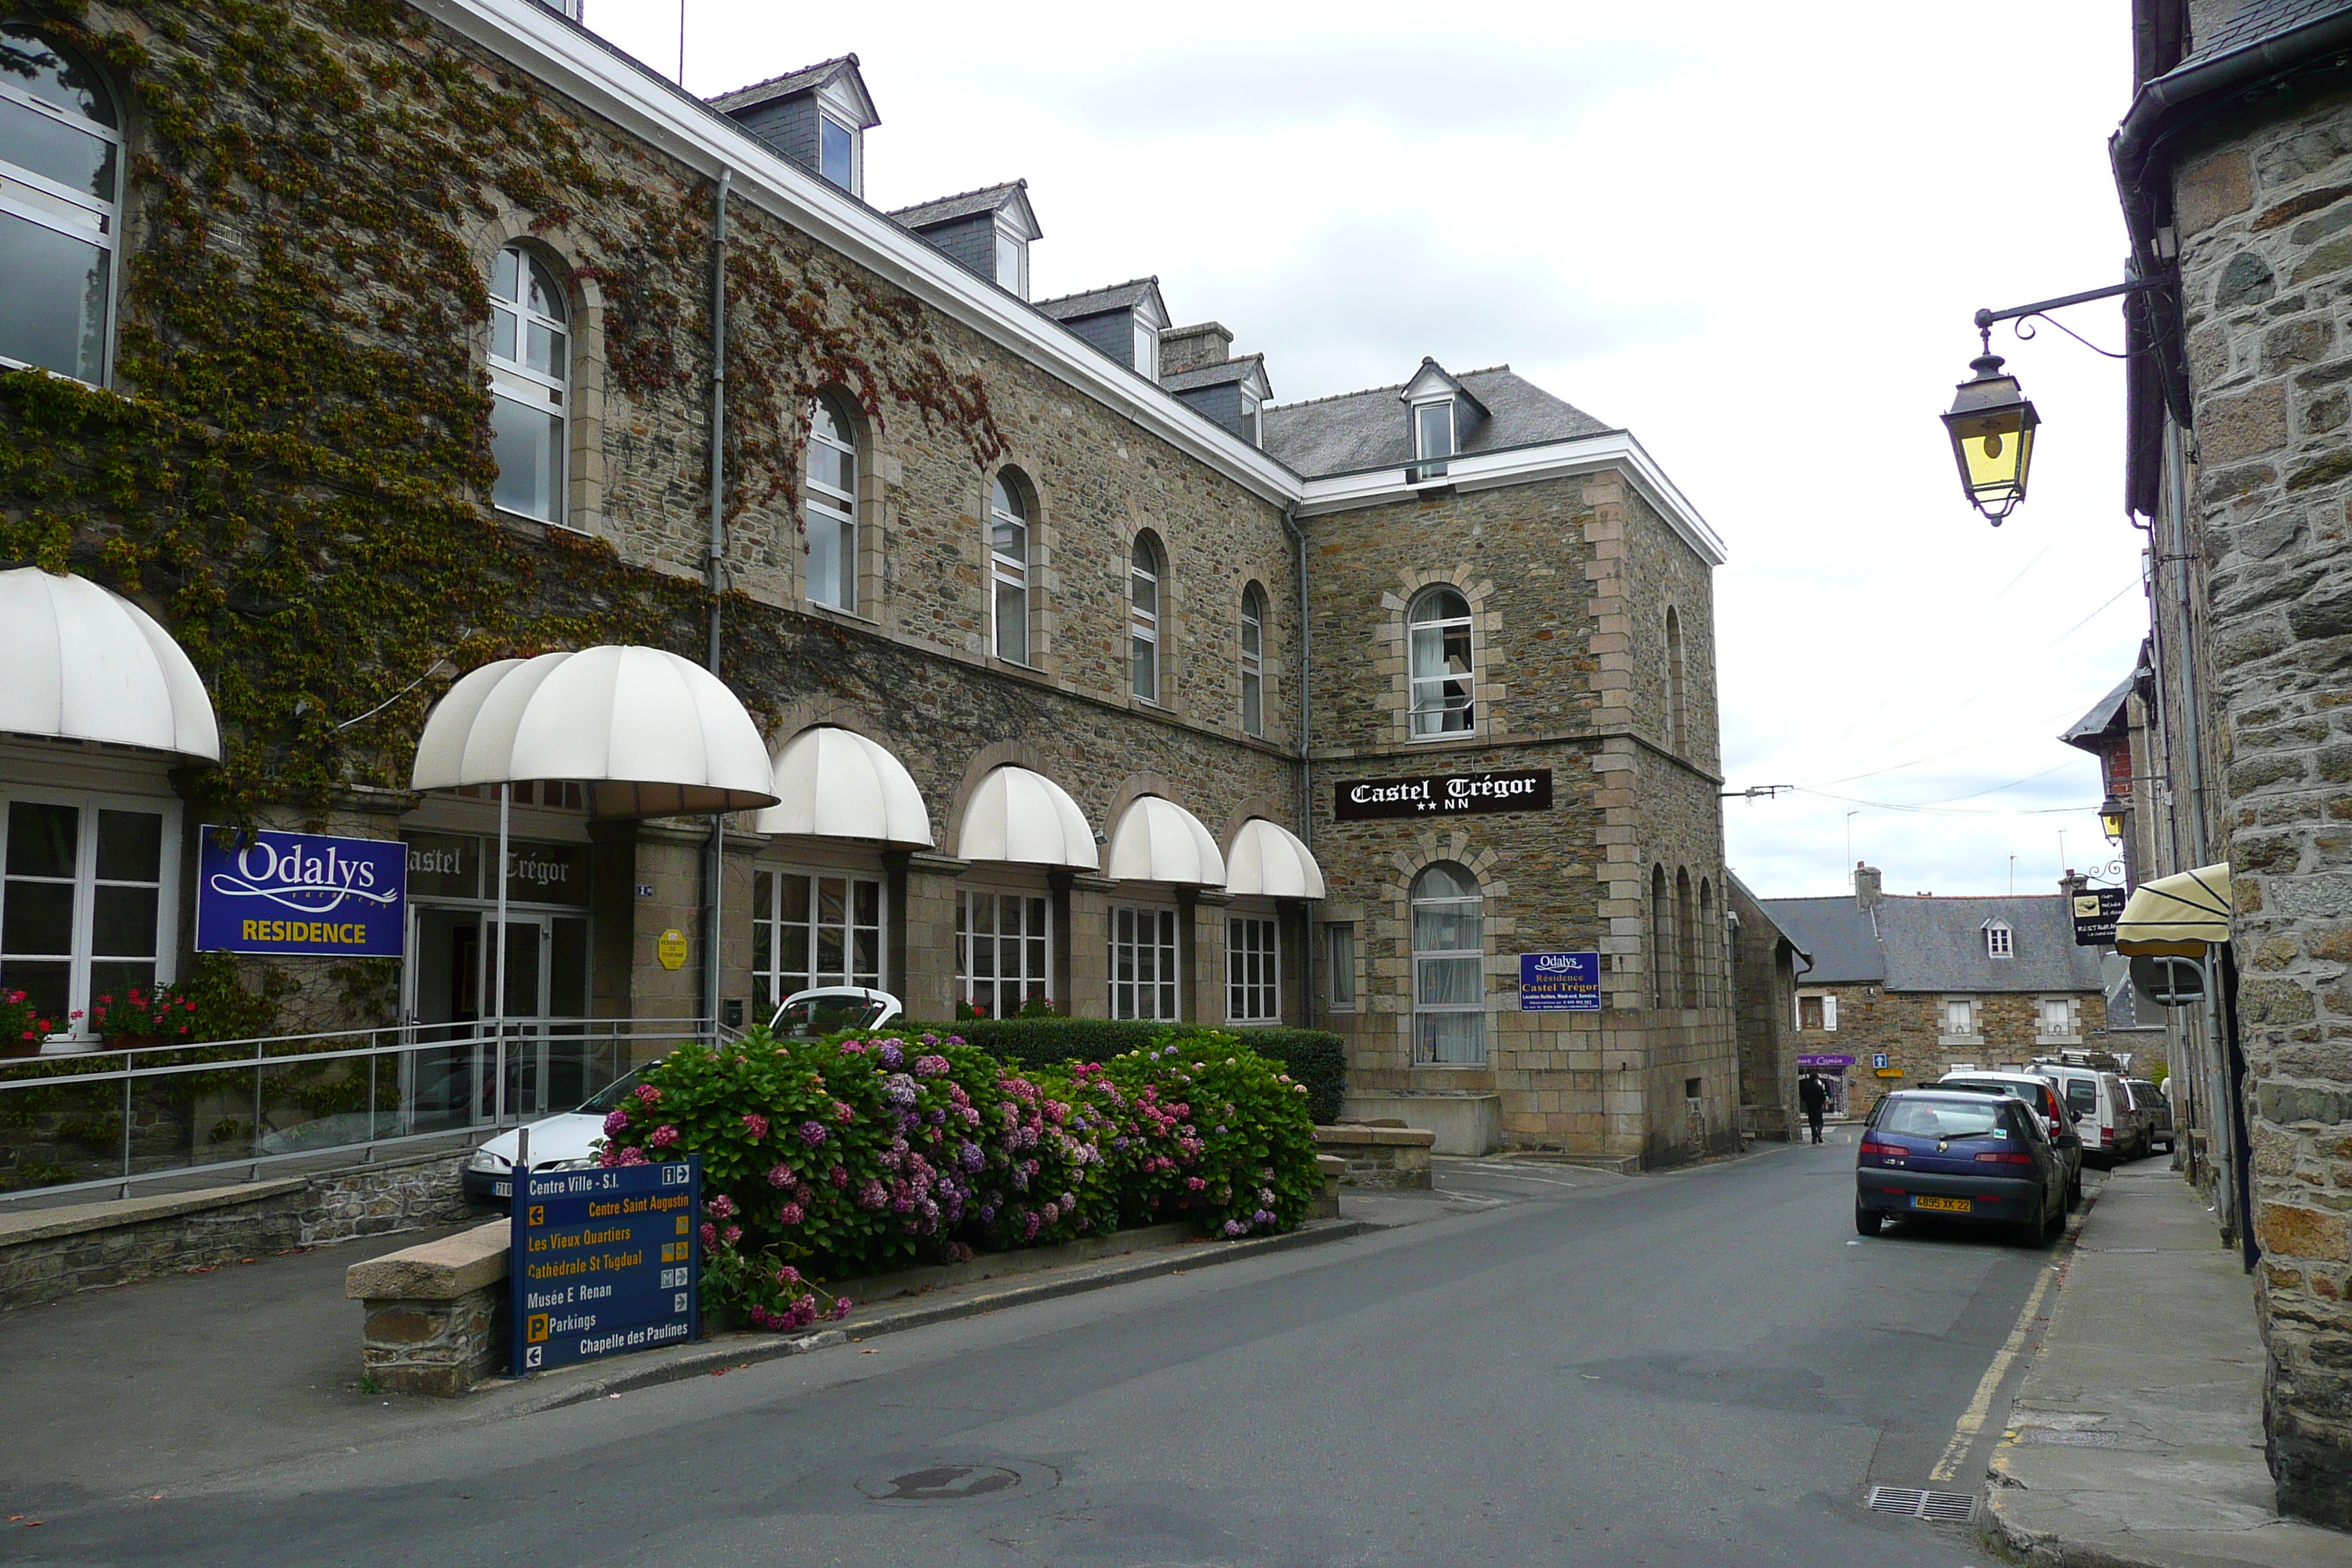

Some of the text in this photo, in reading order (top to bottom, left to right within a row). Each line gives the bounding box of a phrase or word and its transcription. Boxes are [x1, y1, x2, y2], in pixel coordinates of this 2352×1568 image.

[1350, 774, 1537, 803] Castel Trégor
[238, 842, 375, 889] Odalys
[406, 848, 461, 875] astel
[241, 919, 366, 944] RESIDENCE
[1540, 955, 1578, 967] Odalys
[1522, 983, 1598, 993] Castel Trégor
[1537, 974, 1584, 982] Résidence
[1817, 1057, 1842, 1066] Canin
[529, 1179, 565, 1196] Centre
[568, 1175, 592, 1192] Ville
[603, 1173, 619, 1189] S.I.
[589, 1191, 689, 1217] Centre Saint Augustin
[1917, 1196, 1970, 1210] 4895 XK 22
[528, 1226, 630, 1252] Les Vieux Quartiers
[527, 1249, 642, 1279] Cathédrale St Tugdual
[527, 1289, 564, 1309] Musée
[580, 1284, 611, 1301] Renan
[549, 1313, 596, 1335] Parkings
[580, 1322, 687, 1354] Chapelle des Paulines
